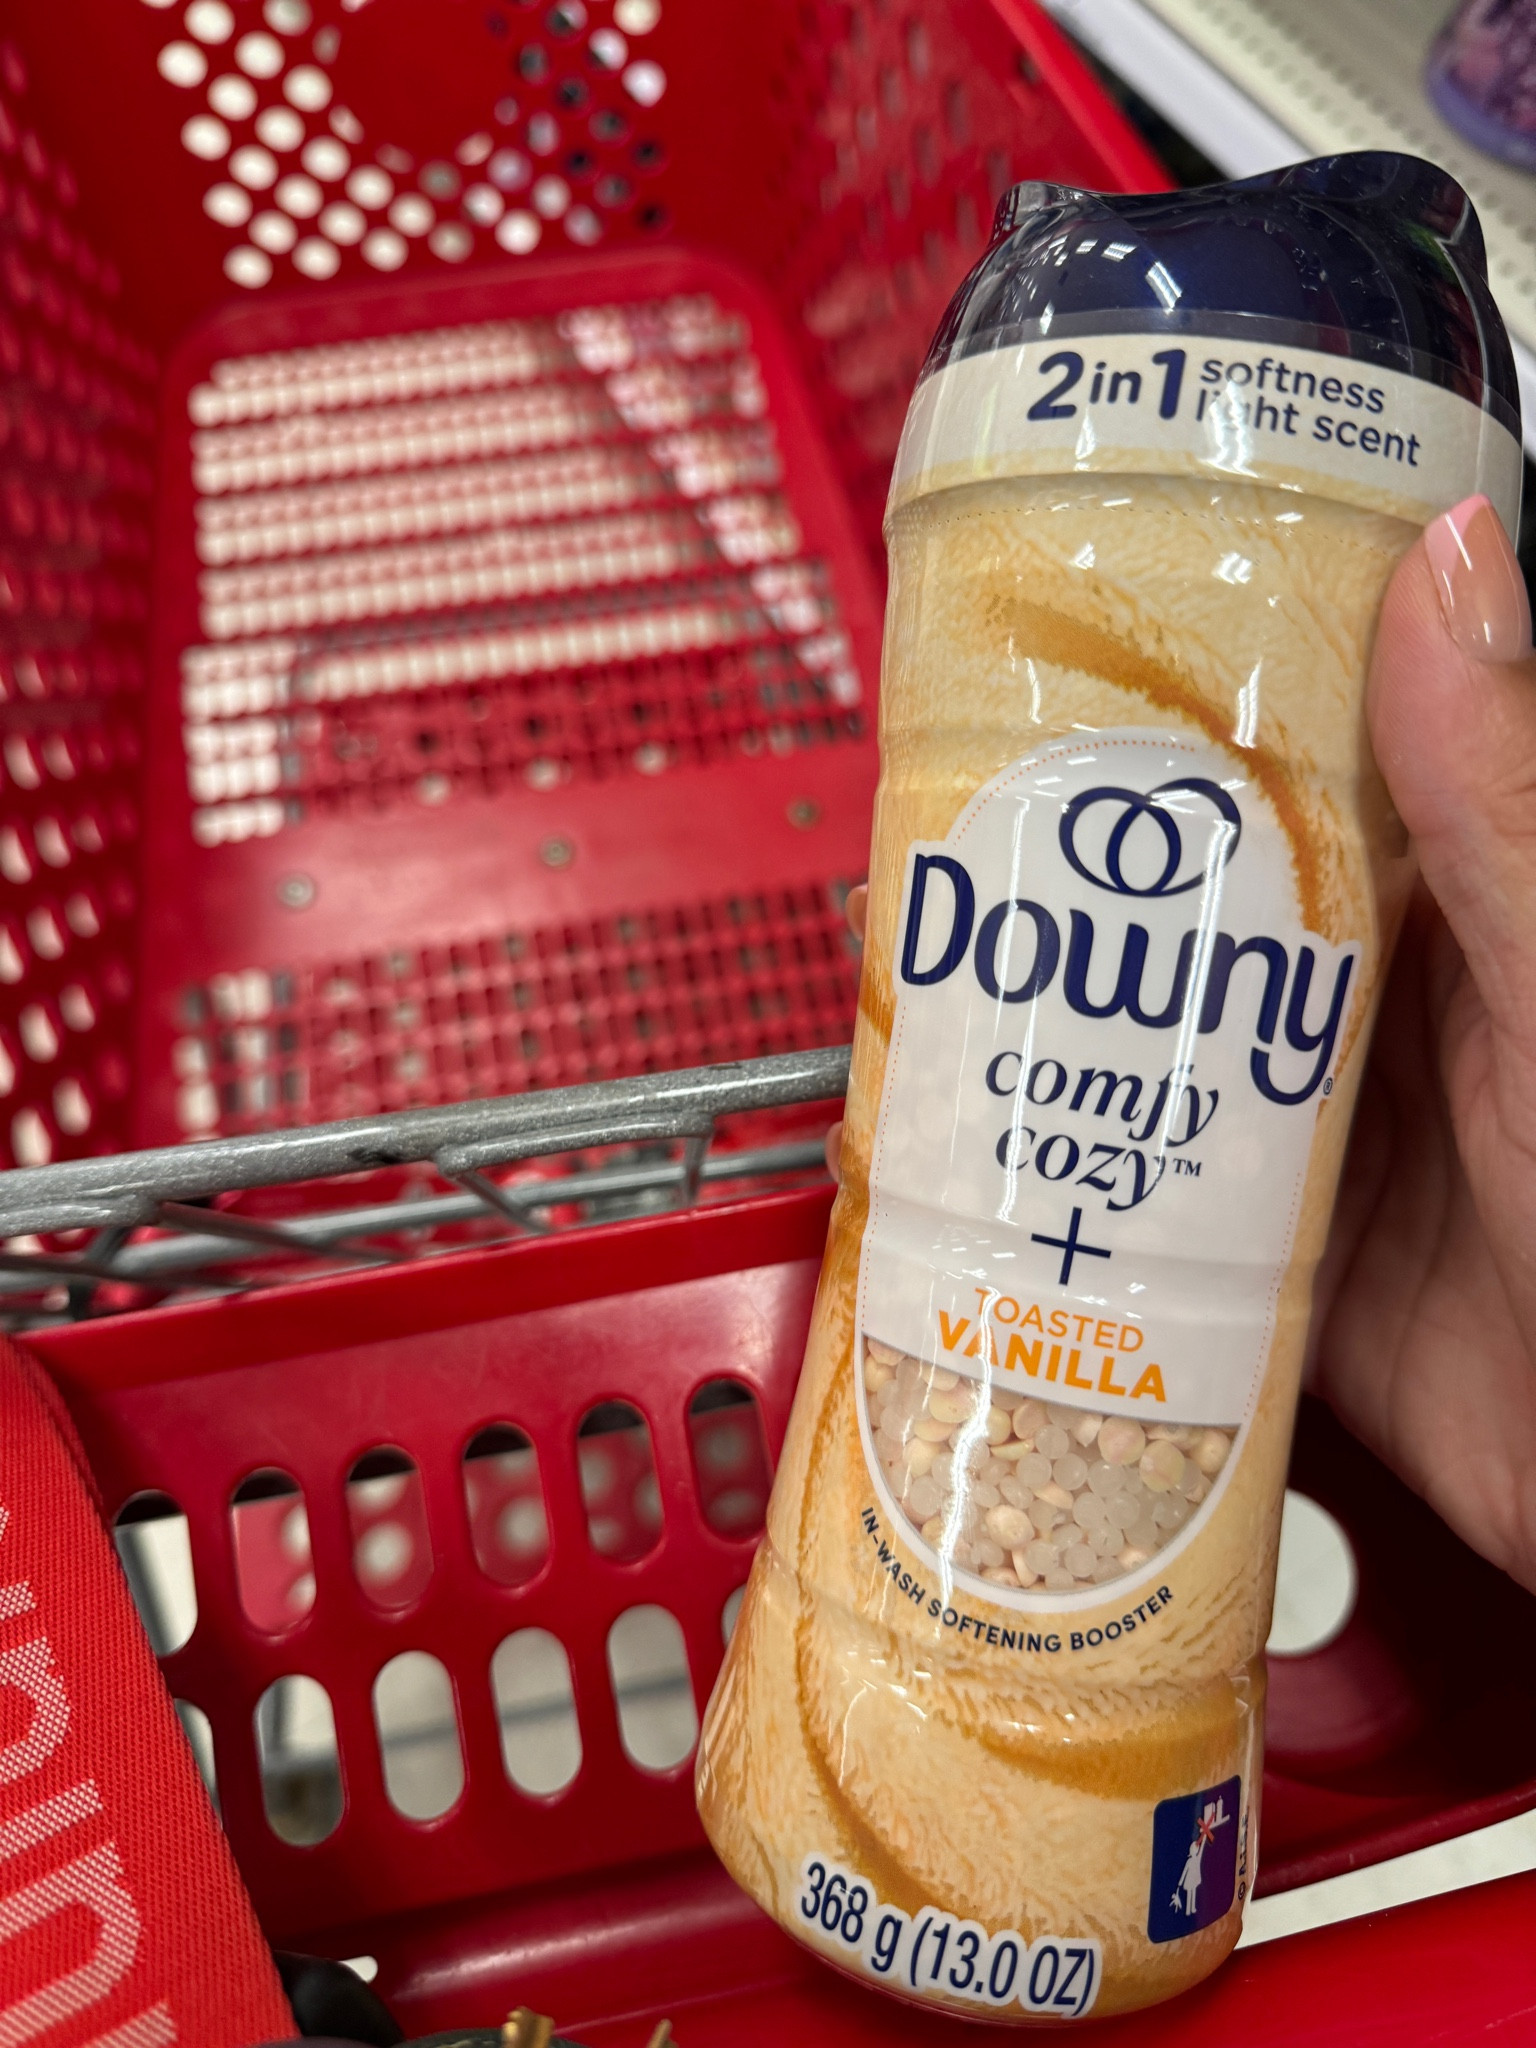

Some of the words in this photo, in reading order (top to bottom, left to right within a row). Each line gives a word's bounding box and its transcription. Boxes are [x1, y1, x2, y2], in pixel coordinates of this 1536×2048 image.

[1027, 350, 1084, 421] 2
[1090, 360, 1143, 404] in
[1152, 348, 1187, 420] 1
[1200, 357, 1386, 414] softness
[1313, 414, 1422, 467] scent
[985, 1050, 1220, 1148] comfy
[938, 1309, 1167, 1403] VANILLA
[974, 1287, 1145, 1354] TOASTED
[860, 1506, 925, 1606] IN-WASH
[927, 1597, 1062, 1653] SOFTENING
[1069, 1585, 1174, 1652] BOOSTER
[801, 1862, 869, 1943] 368
[870, 1914, 902, 1973] g
[908, 1915, 1019, 2000] (13.0
[1028, 1944, 1096, 2017] OZ)
